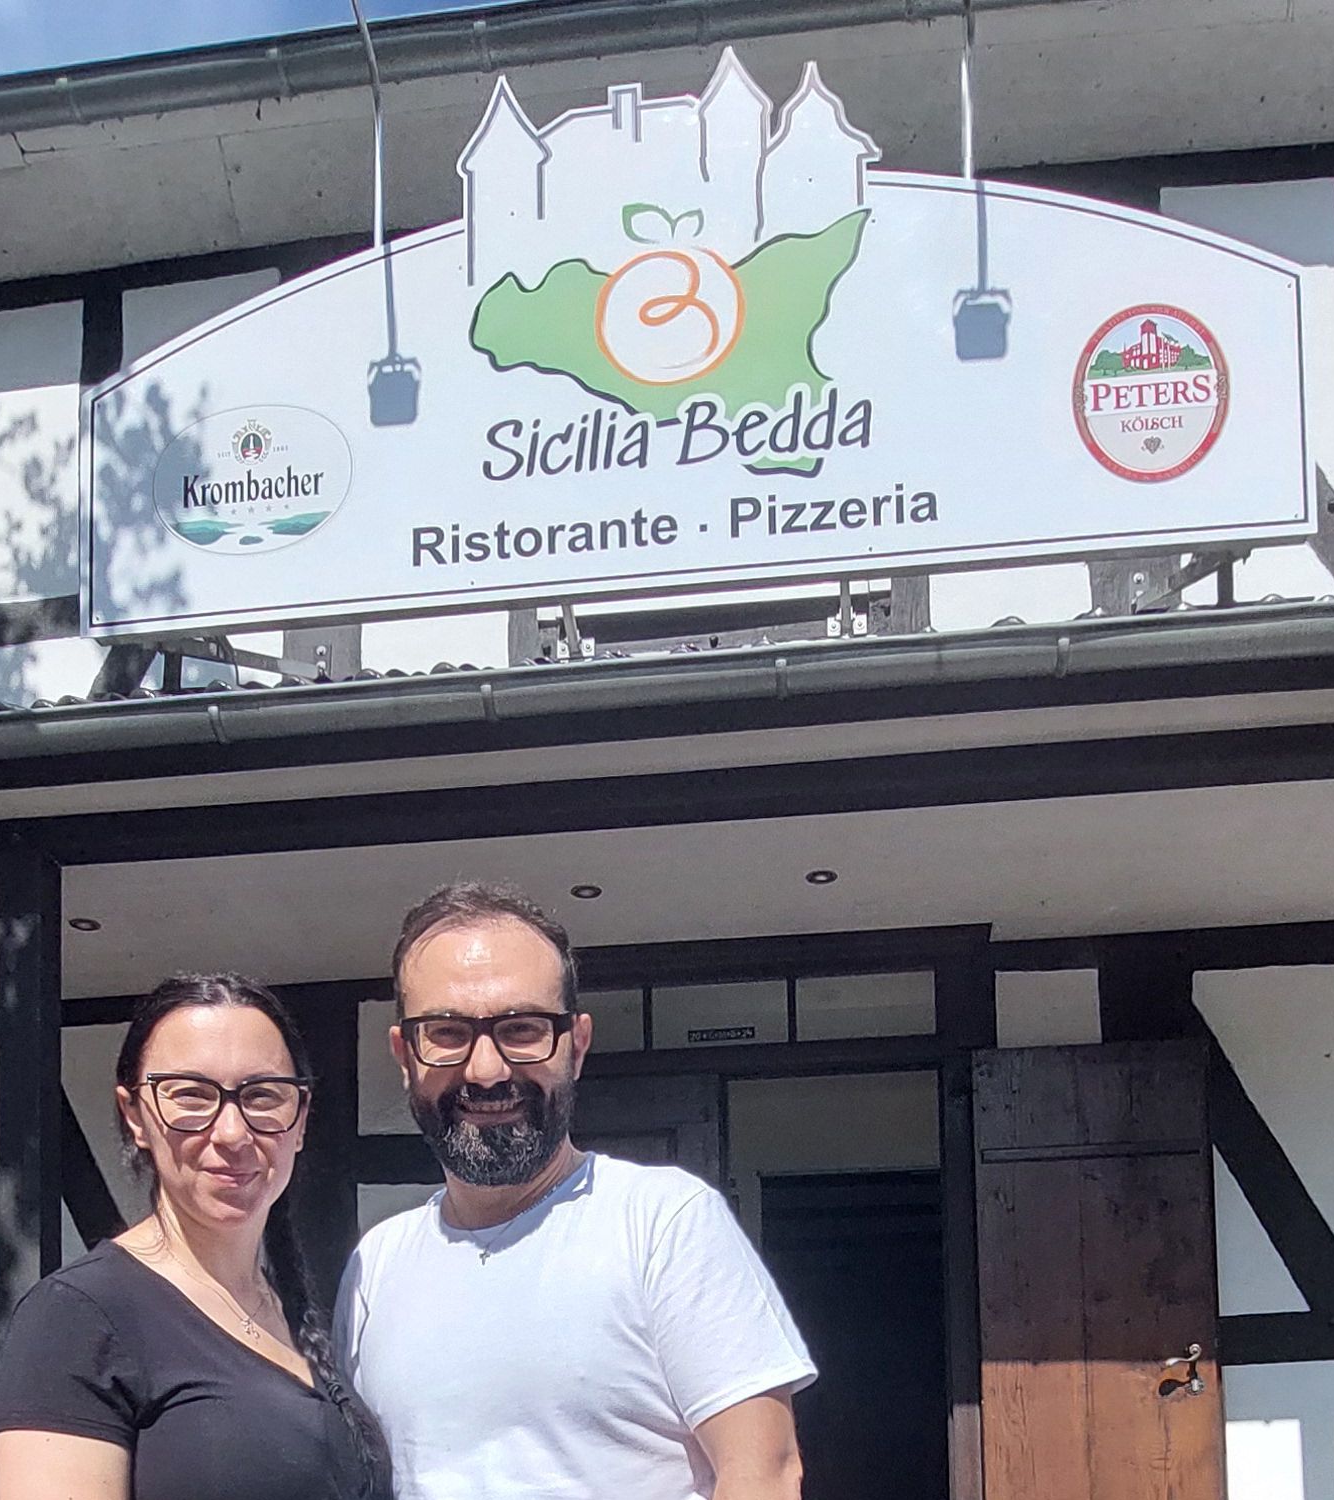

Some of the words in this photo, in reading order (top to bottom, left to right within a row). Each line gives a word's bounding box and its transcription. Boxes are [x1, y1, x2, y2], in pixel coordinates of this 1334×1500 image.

[1090, 375, 1212, 412] PETERS
[482, 409, 649, 480] Sicilia
[676, 388, 873, 465] Bedda
[1120, 416, 1184, 433] KÖLSCH
[182, 465, 324, 508] Krombacher
[411, 509, 679, 567] Ristorante
[730, 483, 939, 538] Pizzeria
